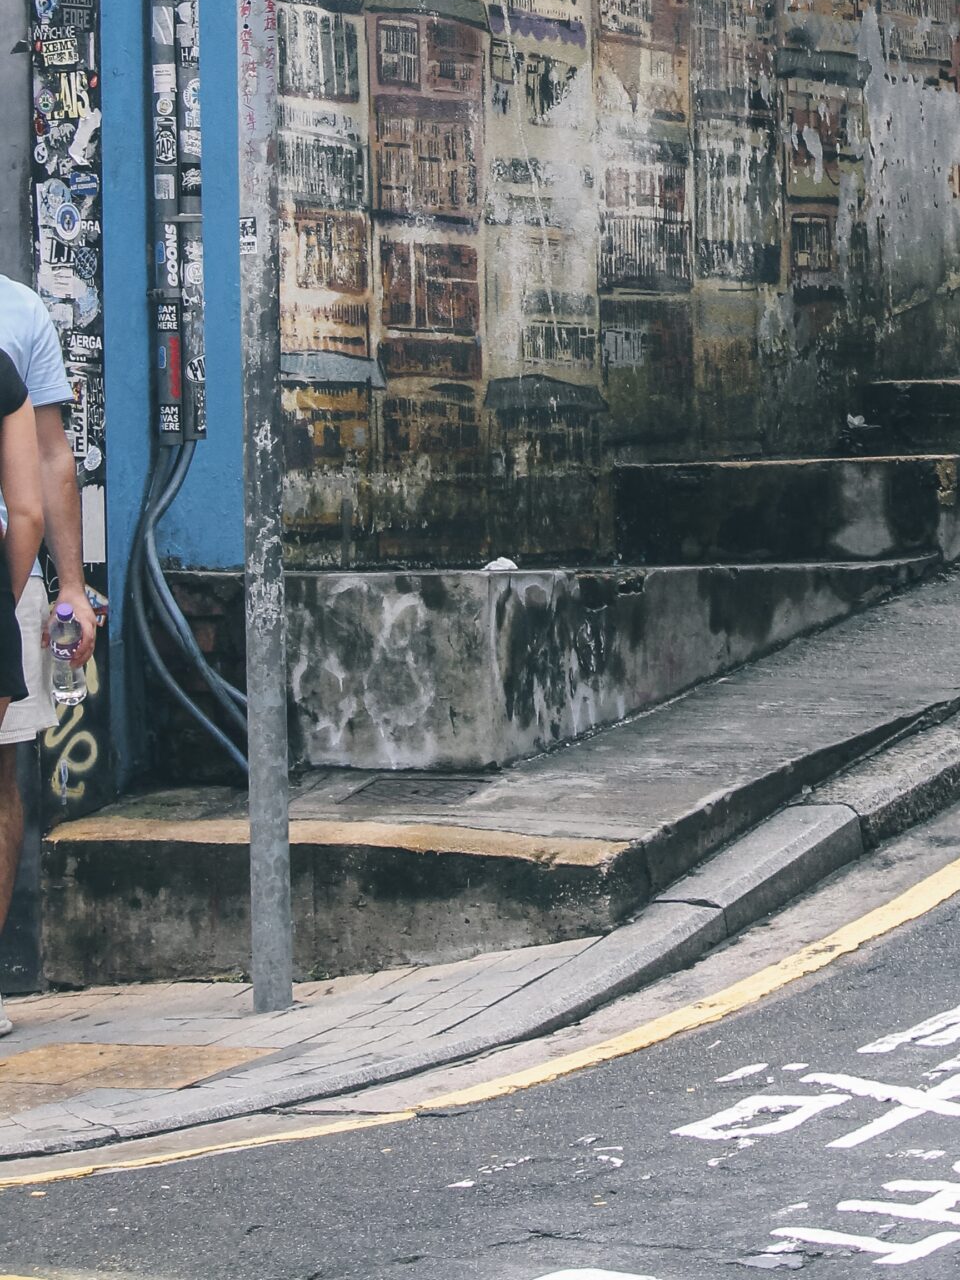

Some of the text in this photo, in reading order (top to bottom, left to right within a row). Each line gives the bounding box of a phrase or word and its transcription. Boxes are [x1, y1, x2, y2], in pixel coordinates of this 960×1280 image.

[165, 224, 179, 287] GOONS
[157, 322, 178, 330] HERE
[69, 334, 103, 350] AERGA
[160, 406, 179, 414] SAM
